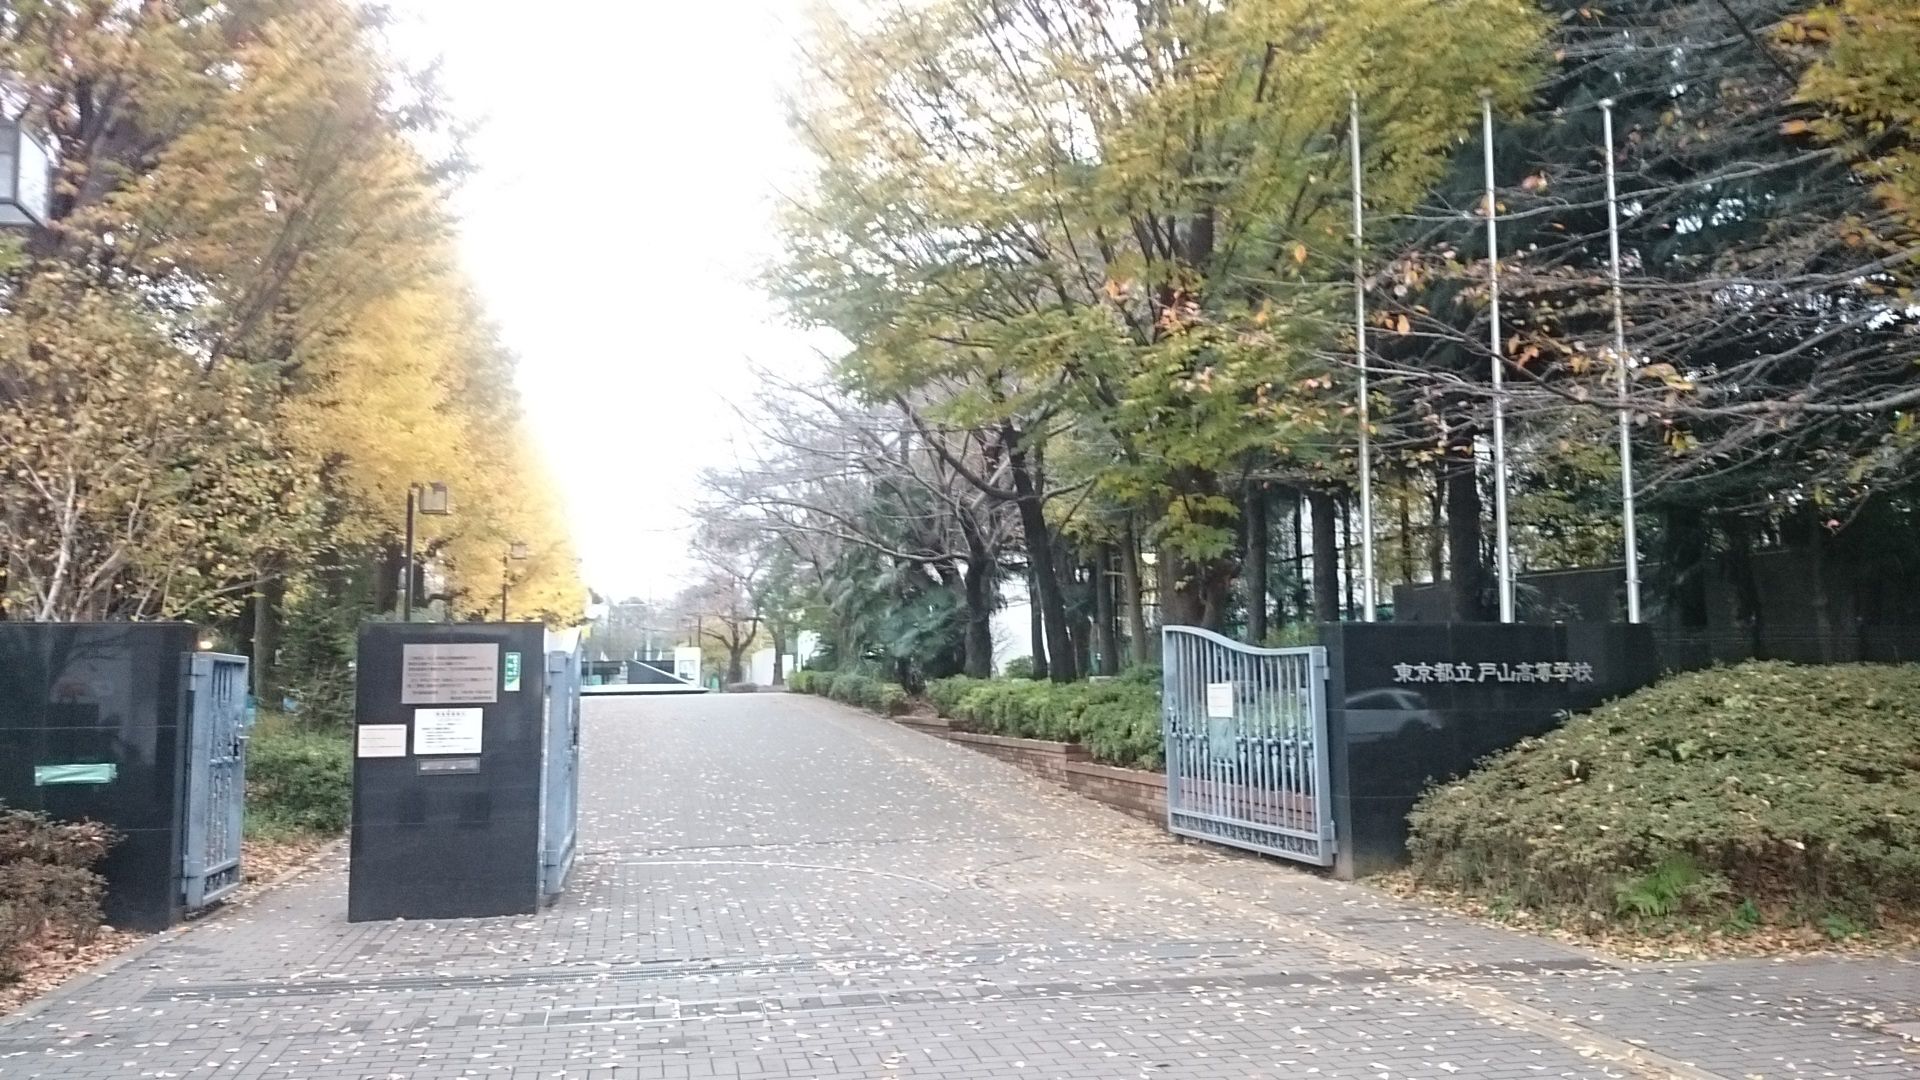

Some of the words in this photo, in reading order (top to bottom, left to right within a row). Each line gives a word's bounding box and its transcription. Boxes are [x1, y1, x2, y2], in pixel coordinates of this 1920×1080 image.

[1393, 662, 1594, 683] 東京都立戸山高等学校
